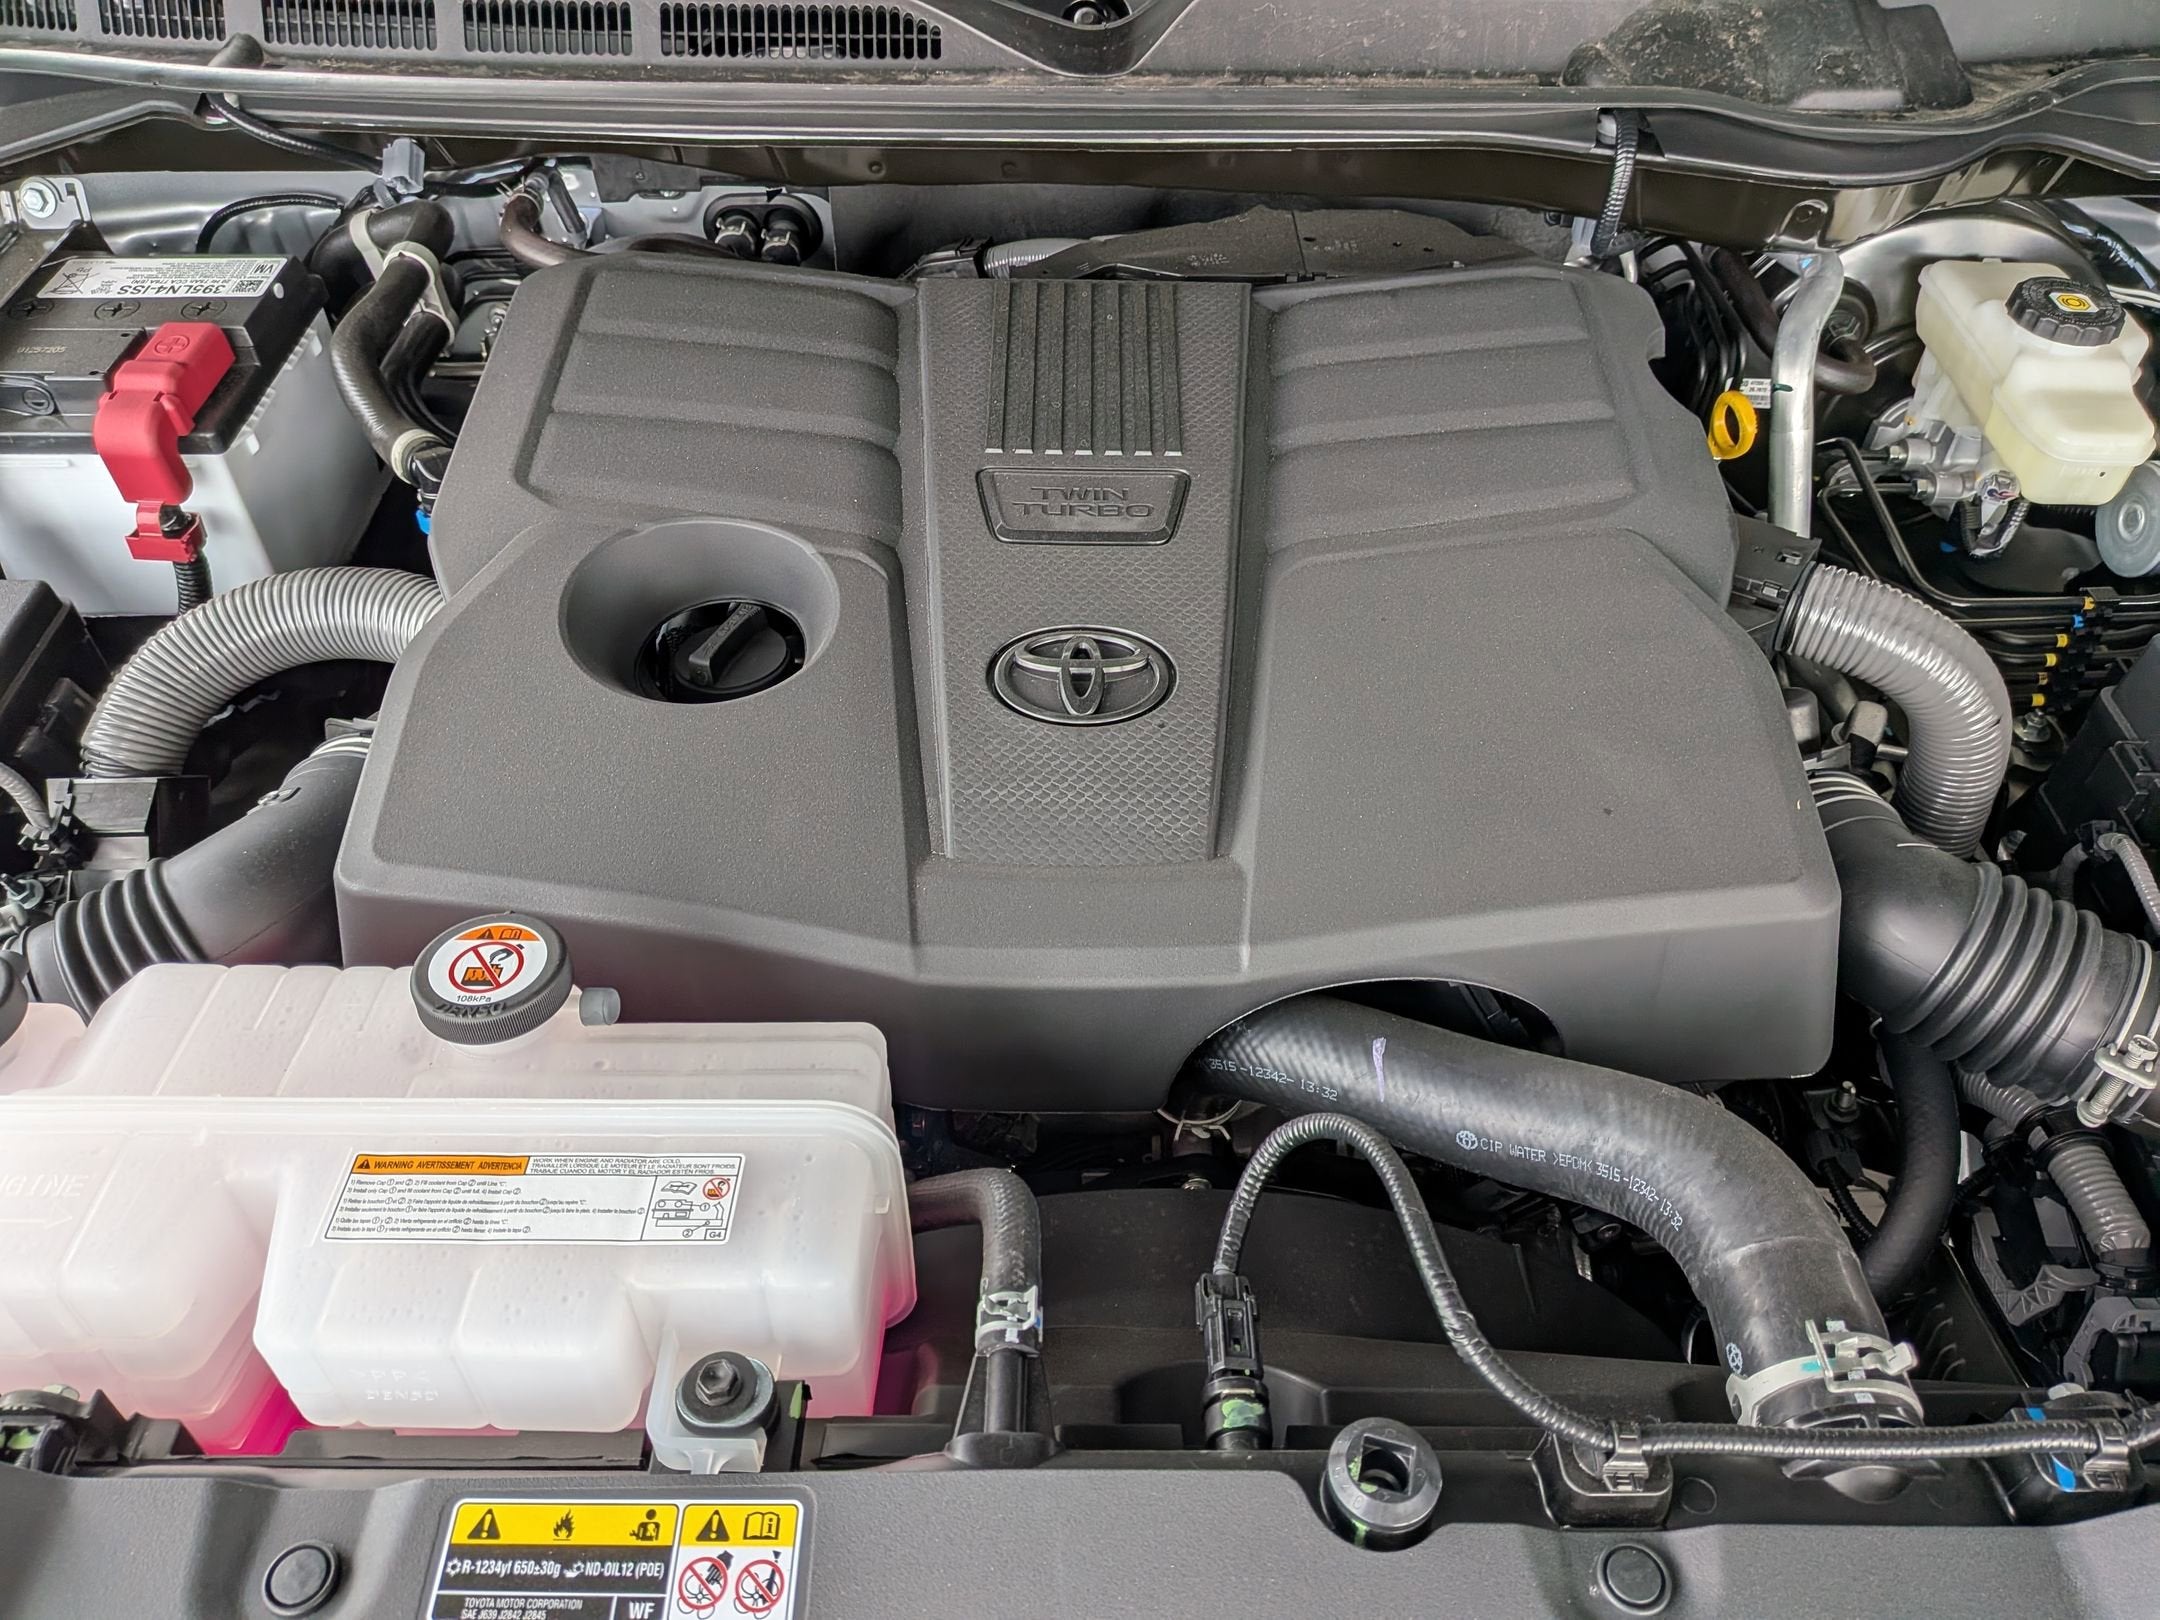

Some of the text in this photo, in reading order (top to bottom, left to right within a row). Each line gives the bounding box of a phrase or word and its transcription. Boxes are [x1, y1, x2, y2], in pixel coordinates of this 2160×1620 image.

[117, 284, 226, 295] 395LN4-ISS
[1030, 486, 1130, 501] TWIN
[1011, 501, 1155, 518] TURBO
[456, 995, 492, 1003] 108kPa
[433, 1003, 507, 1018] DENSO
[1208, 1058, 1237, 1072] 3515
[1300, 1078, 1338, 1101] 13:32
[373, 1160, 522, 1170] WARNING AVERTISSEMENT ADVERTENCIA
[1480, 1139, 1503, 1152] CIP
[1509, 1144, 1547, 1163] WATER
[1595, 1161, 1621, 1182] 3515
[461, 1559, 665, 1580] R-1234yf 650±30g ND-OIL12 (POE)
[464, 1596, 583, 1610] TOYOTA MOTOR CORPORATION
[628, 1602, 655, 1619] WF
[461, 1608, 477, 1619] SAE
[498, 1609, 522, 1620] J2842
